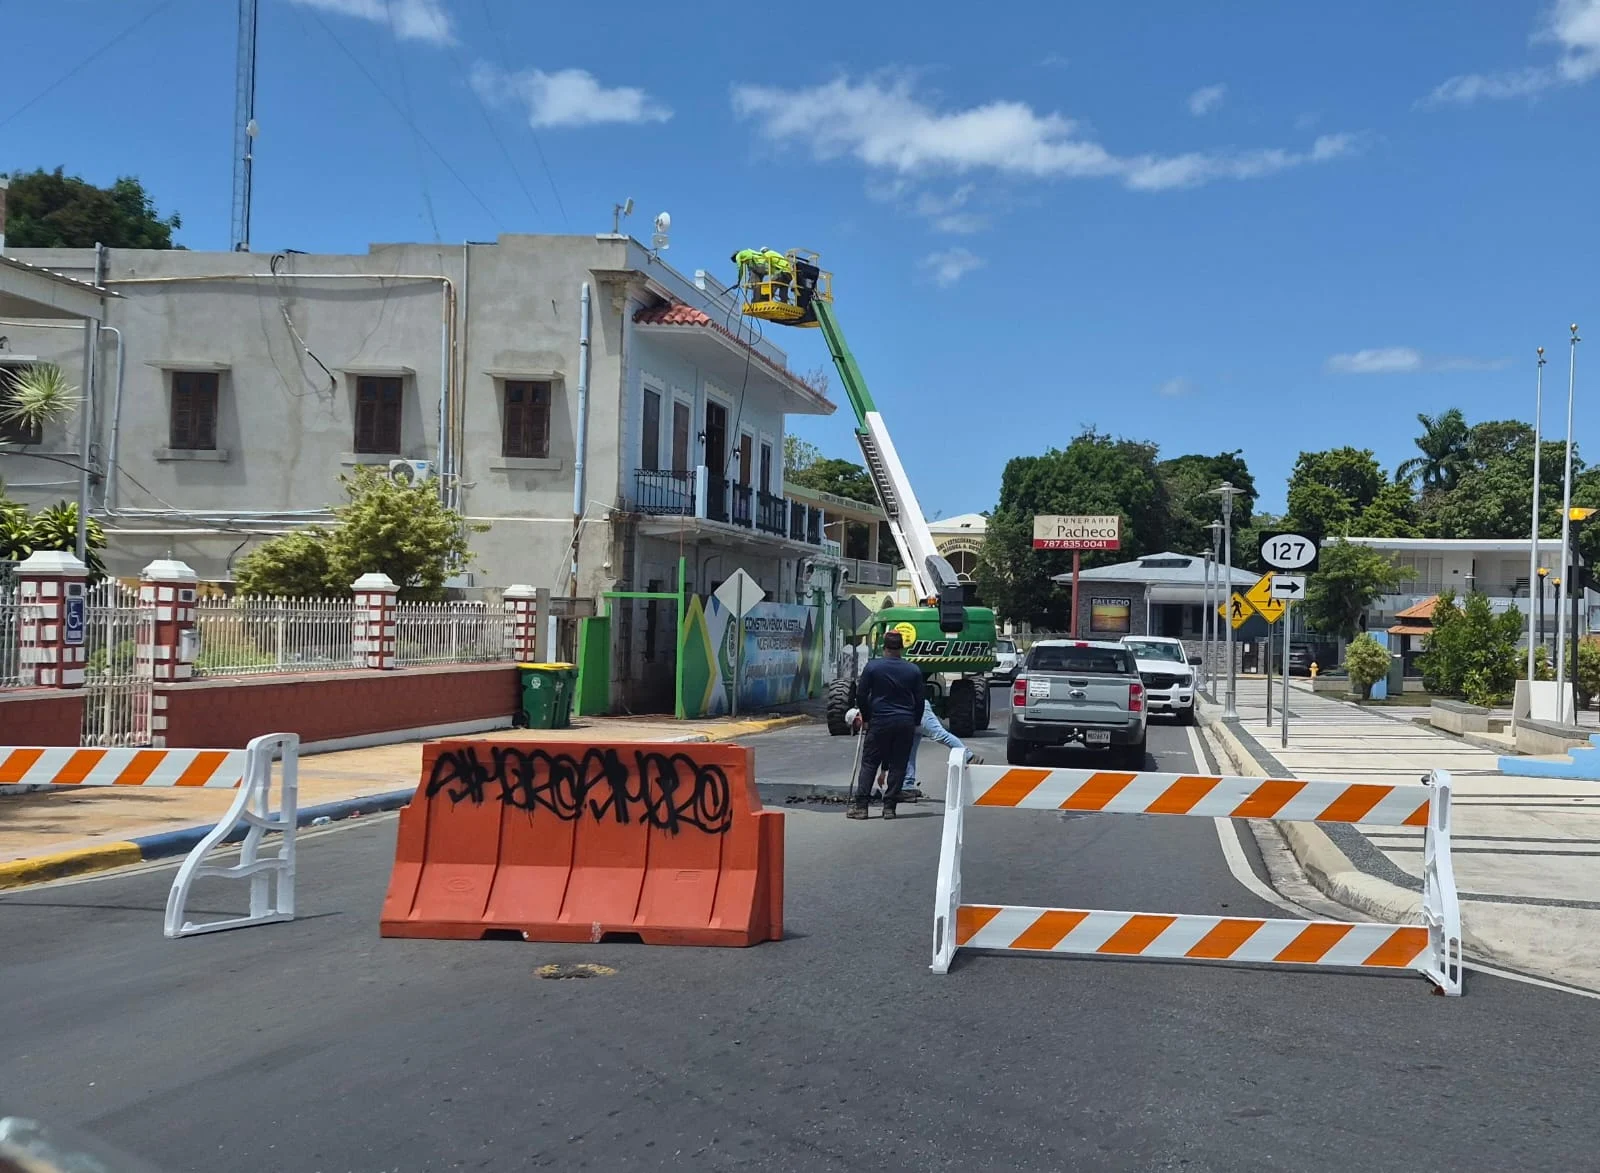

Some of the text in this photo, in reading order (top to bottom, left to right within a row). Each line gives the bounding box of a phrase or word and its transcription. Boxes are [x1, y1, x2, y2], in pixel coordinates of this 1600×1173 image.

[1057, 525, 1116, 538] Pacheco
[1043, 540, 1107, 548] 787.835.0041
[1272, 542, 1306, 560] 127
[906, 640, 990, 657] JLG LIFT
